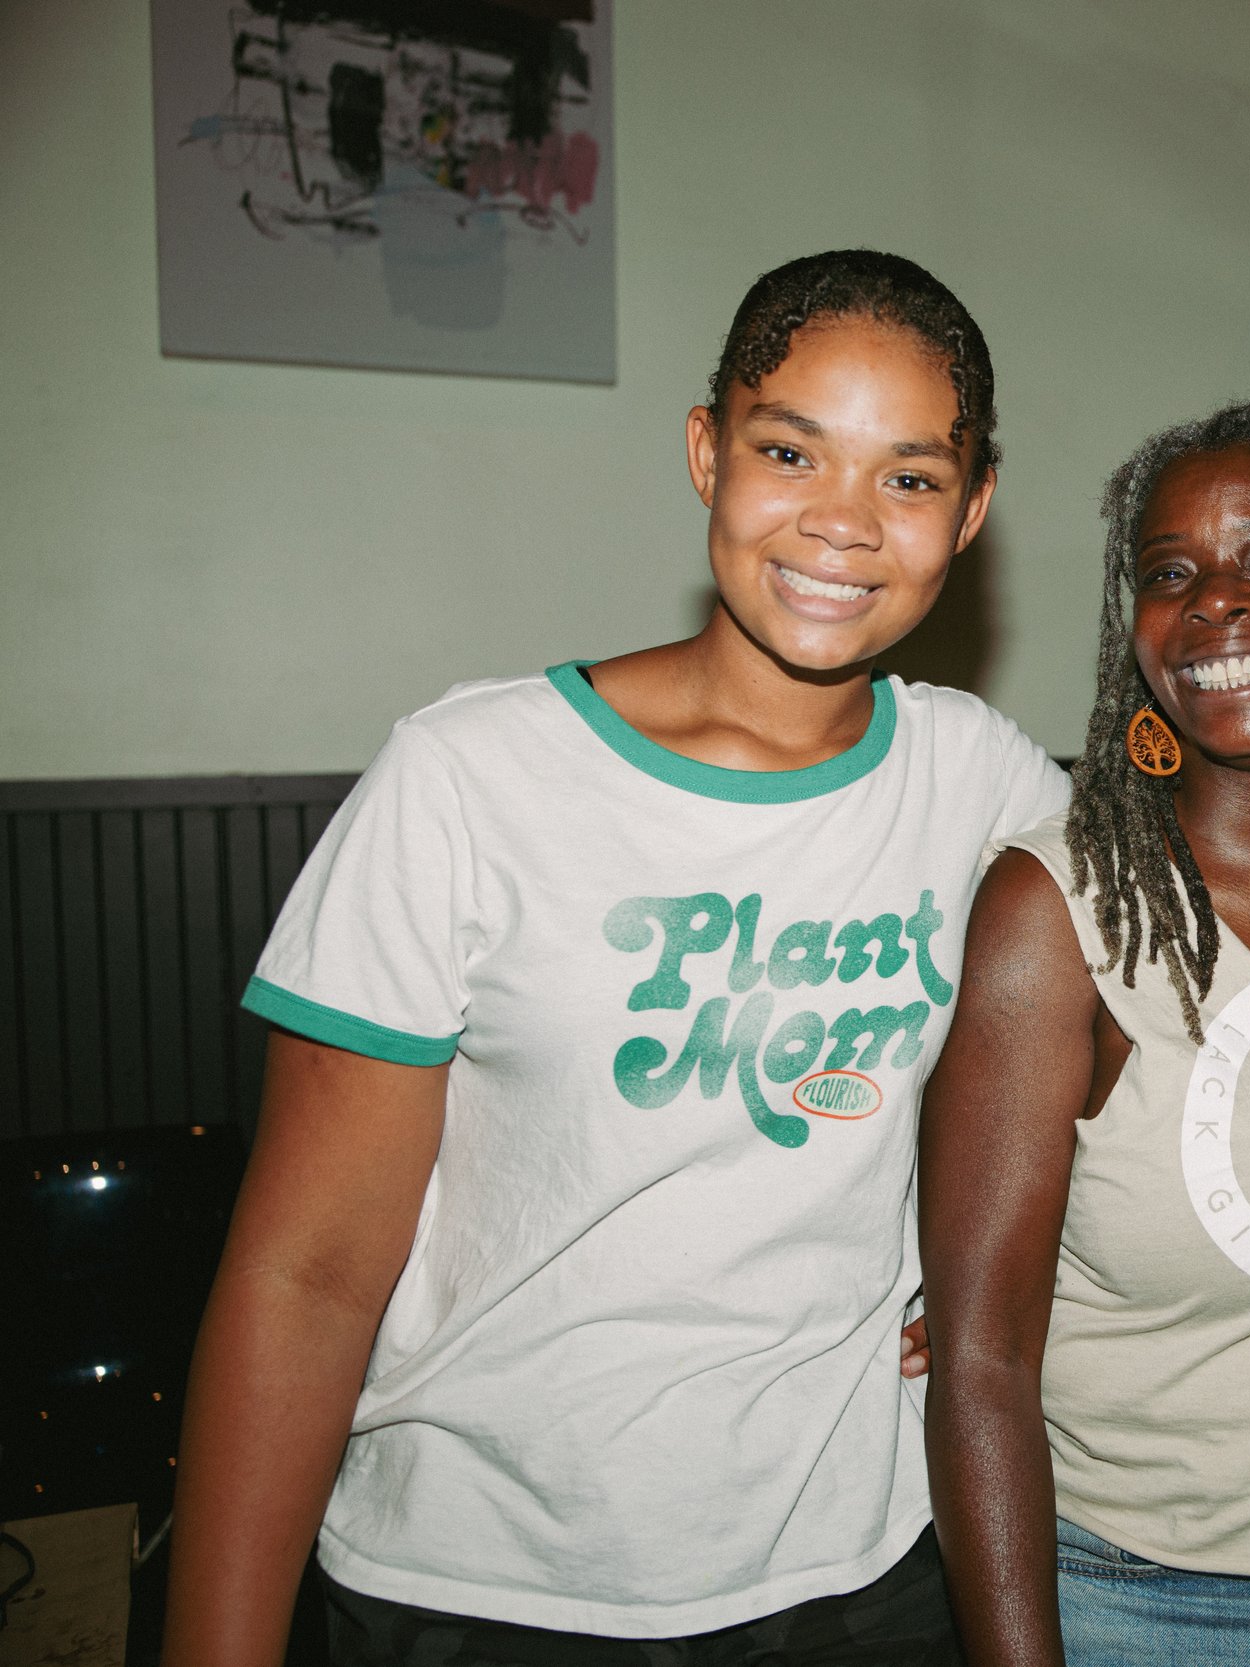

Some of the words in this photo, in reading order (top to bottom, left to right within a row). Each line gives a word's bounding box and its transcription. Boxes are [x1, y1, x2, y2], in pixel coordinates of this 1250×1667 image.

[603, 889, 953, 1011] Plant
[613, 991, 931, 1148] Mom
[803, 1078, 872, 1110] FLOURISH
